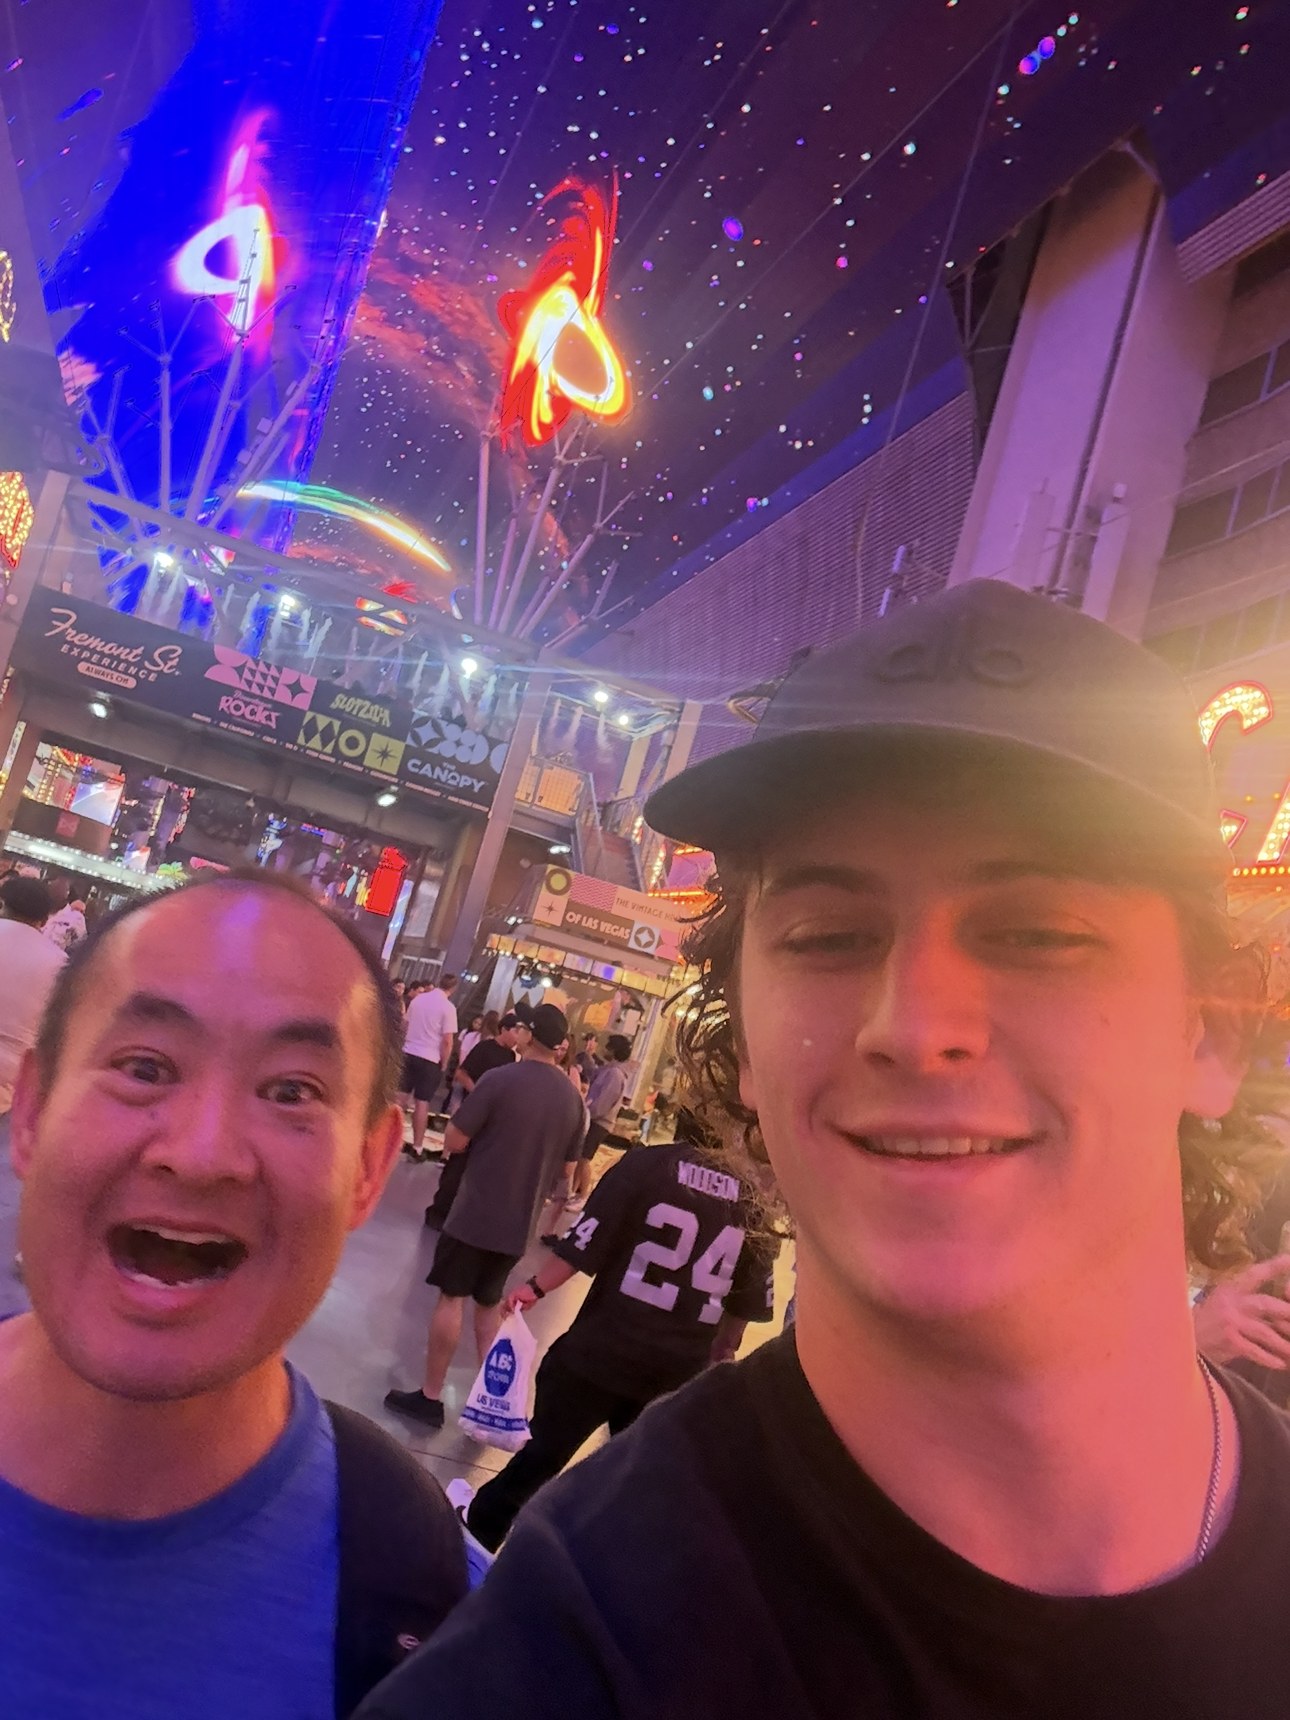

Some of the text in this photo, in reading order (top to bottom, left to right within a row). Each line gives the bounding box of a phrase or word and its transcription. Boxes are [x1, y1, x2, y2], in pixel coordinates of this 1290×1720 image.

[44, 607, 183, 675] Fremont St.
[60, 643, 158, 682] EXPERIENCE
[85, 665, 116, 681] ALWAYS
[219, 695, 280, 729] ROCKS
[407, 759, 486, 793] CANOPY
[615, 897, 629, 909] THE
[565, 911, 631, 940] OF LAS VEGAS
[619, 1202, 746, 1325] 24
